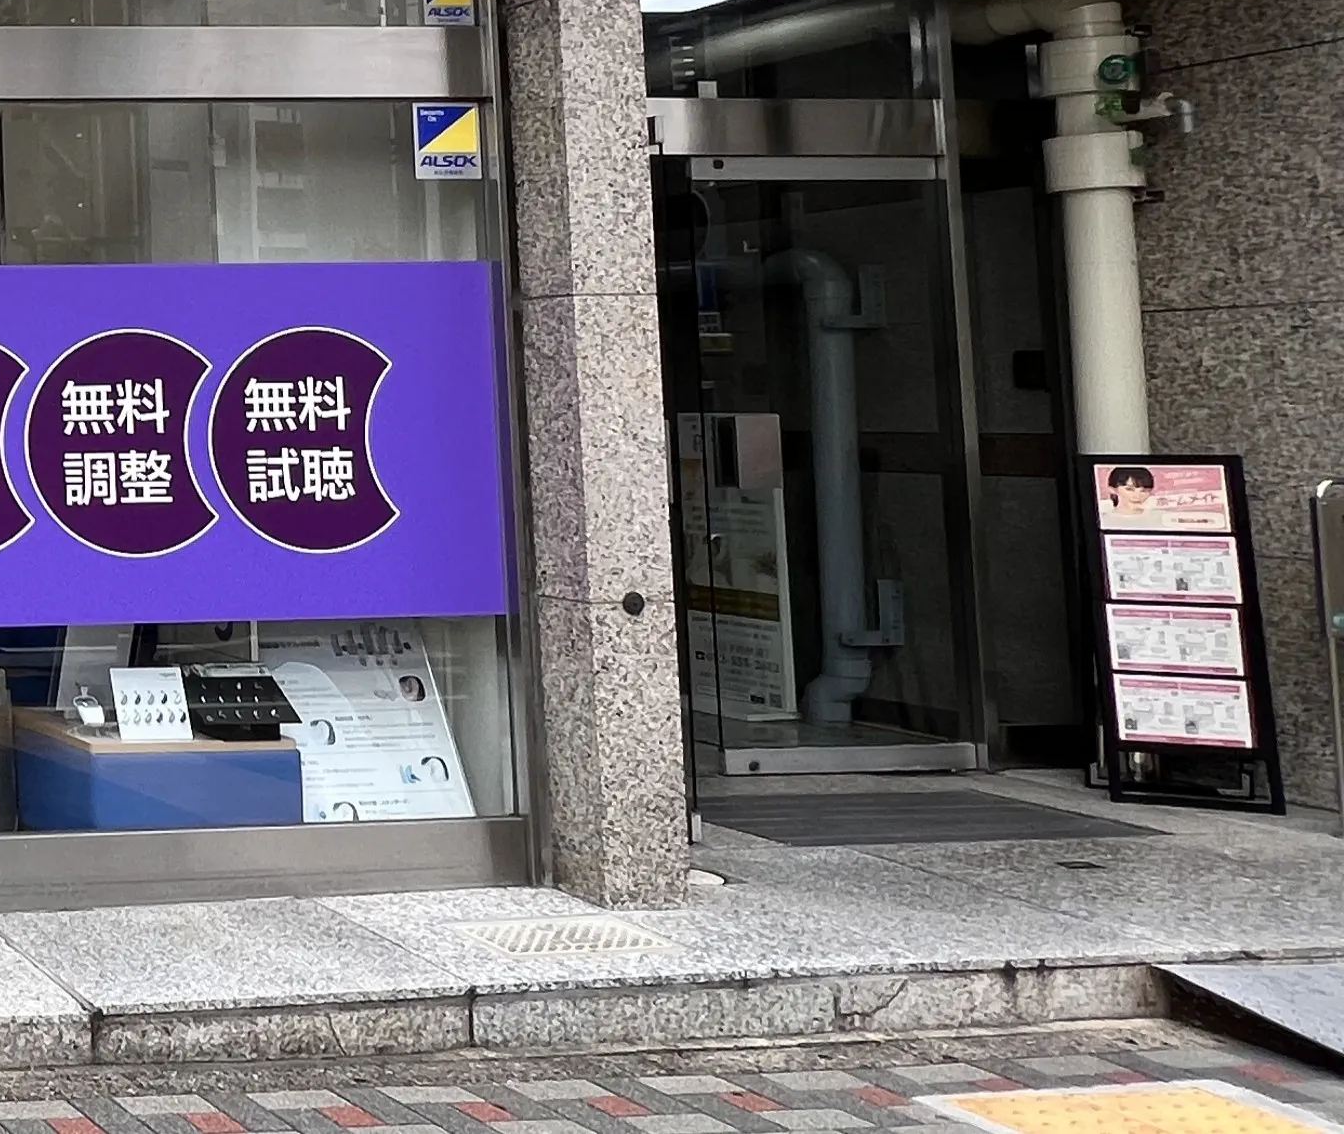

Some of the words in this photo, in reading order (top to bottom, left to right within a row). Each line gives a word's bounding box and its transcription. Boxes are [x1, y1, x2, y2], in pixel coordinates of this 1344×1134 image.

[420, 155, 477, 168] ALSOK
[60, 377, 171, 436] 無料
[243, 375, 352, 433] 無料
[63, 449, 174, 507] 調整
[245, 445, 357, 504] 試聴
